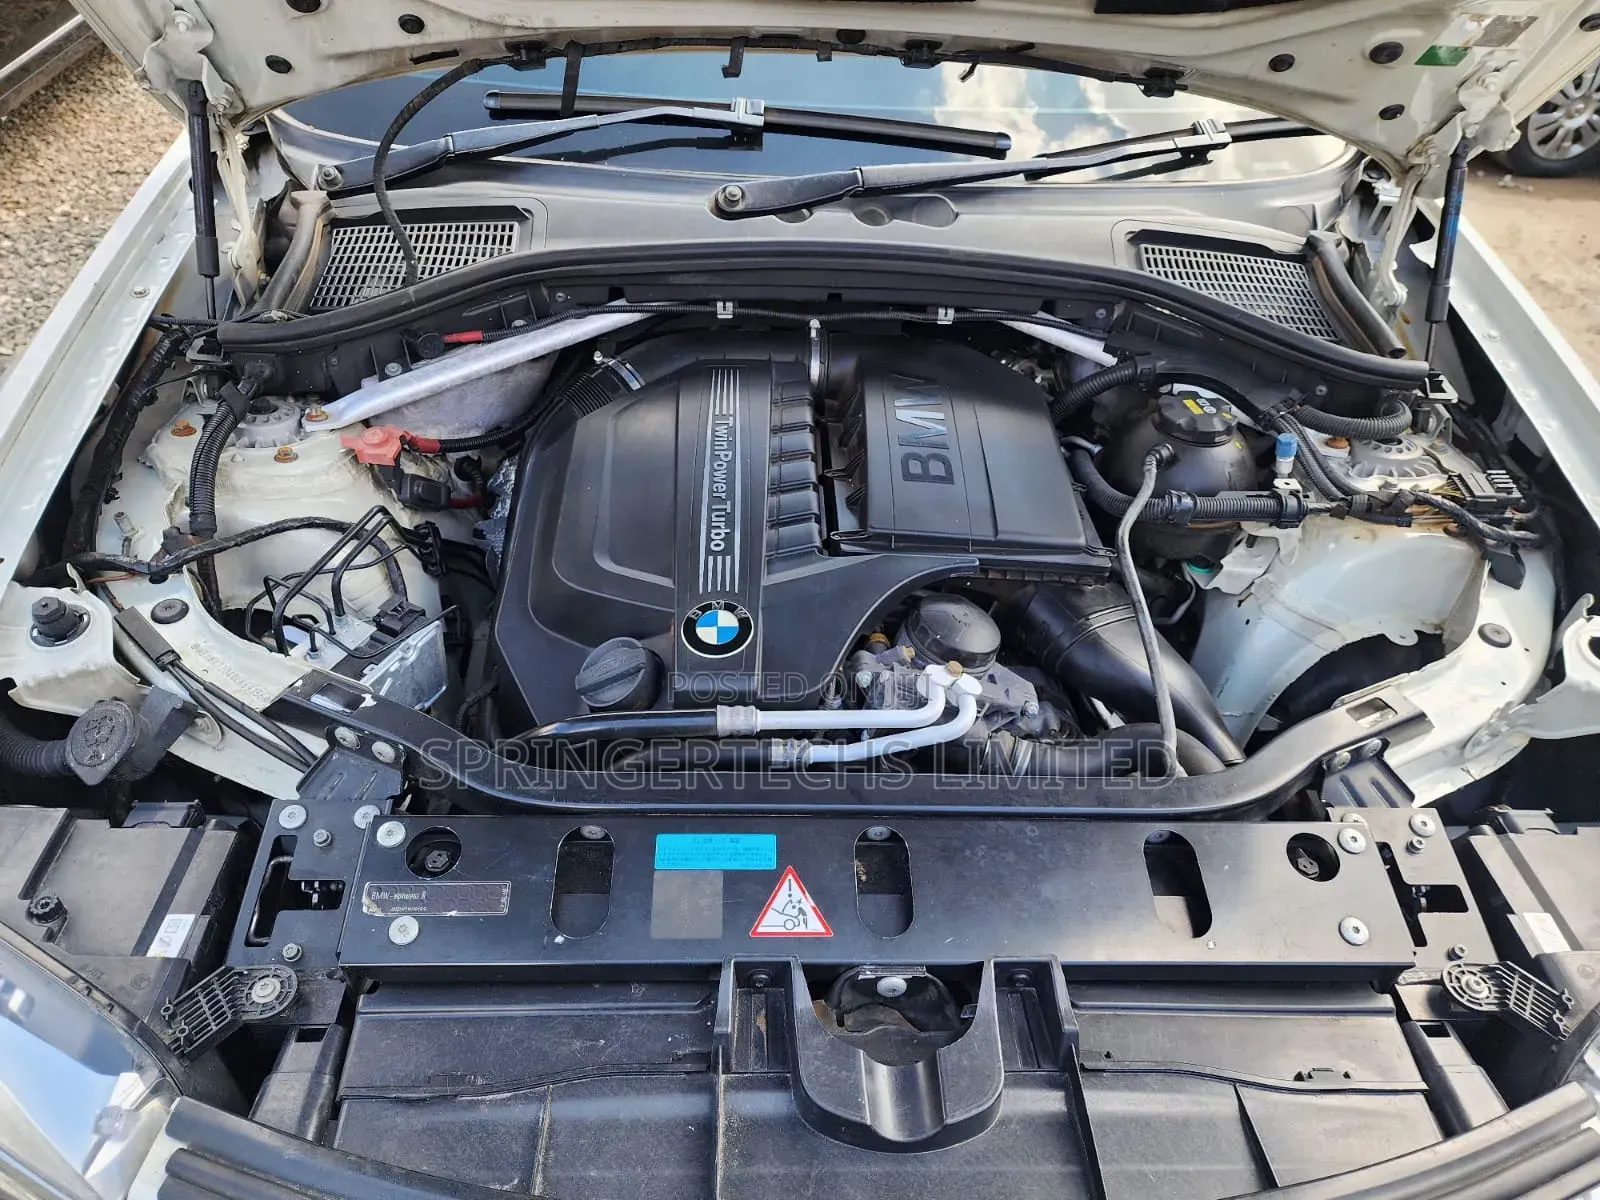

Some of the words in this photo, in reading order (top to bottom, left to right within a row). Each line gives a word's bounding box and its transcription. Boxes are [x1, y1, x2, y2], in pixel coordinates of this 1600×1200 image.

[711, 415, 733, 499] TwinPower
[891, 373, 955, 485] BMW
[710, 501, 731, 552] Turbo
[688, 600, 749, 620] BMW
